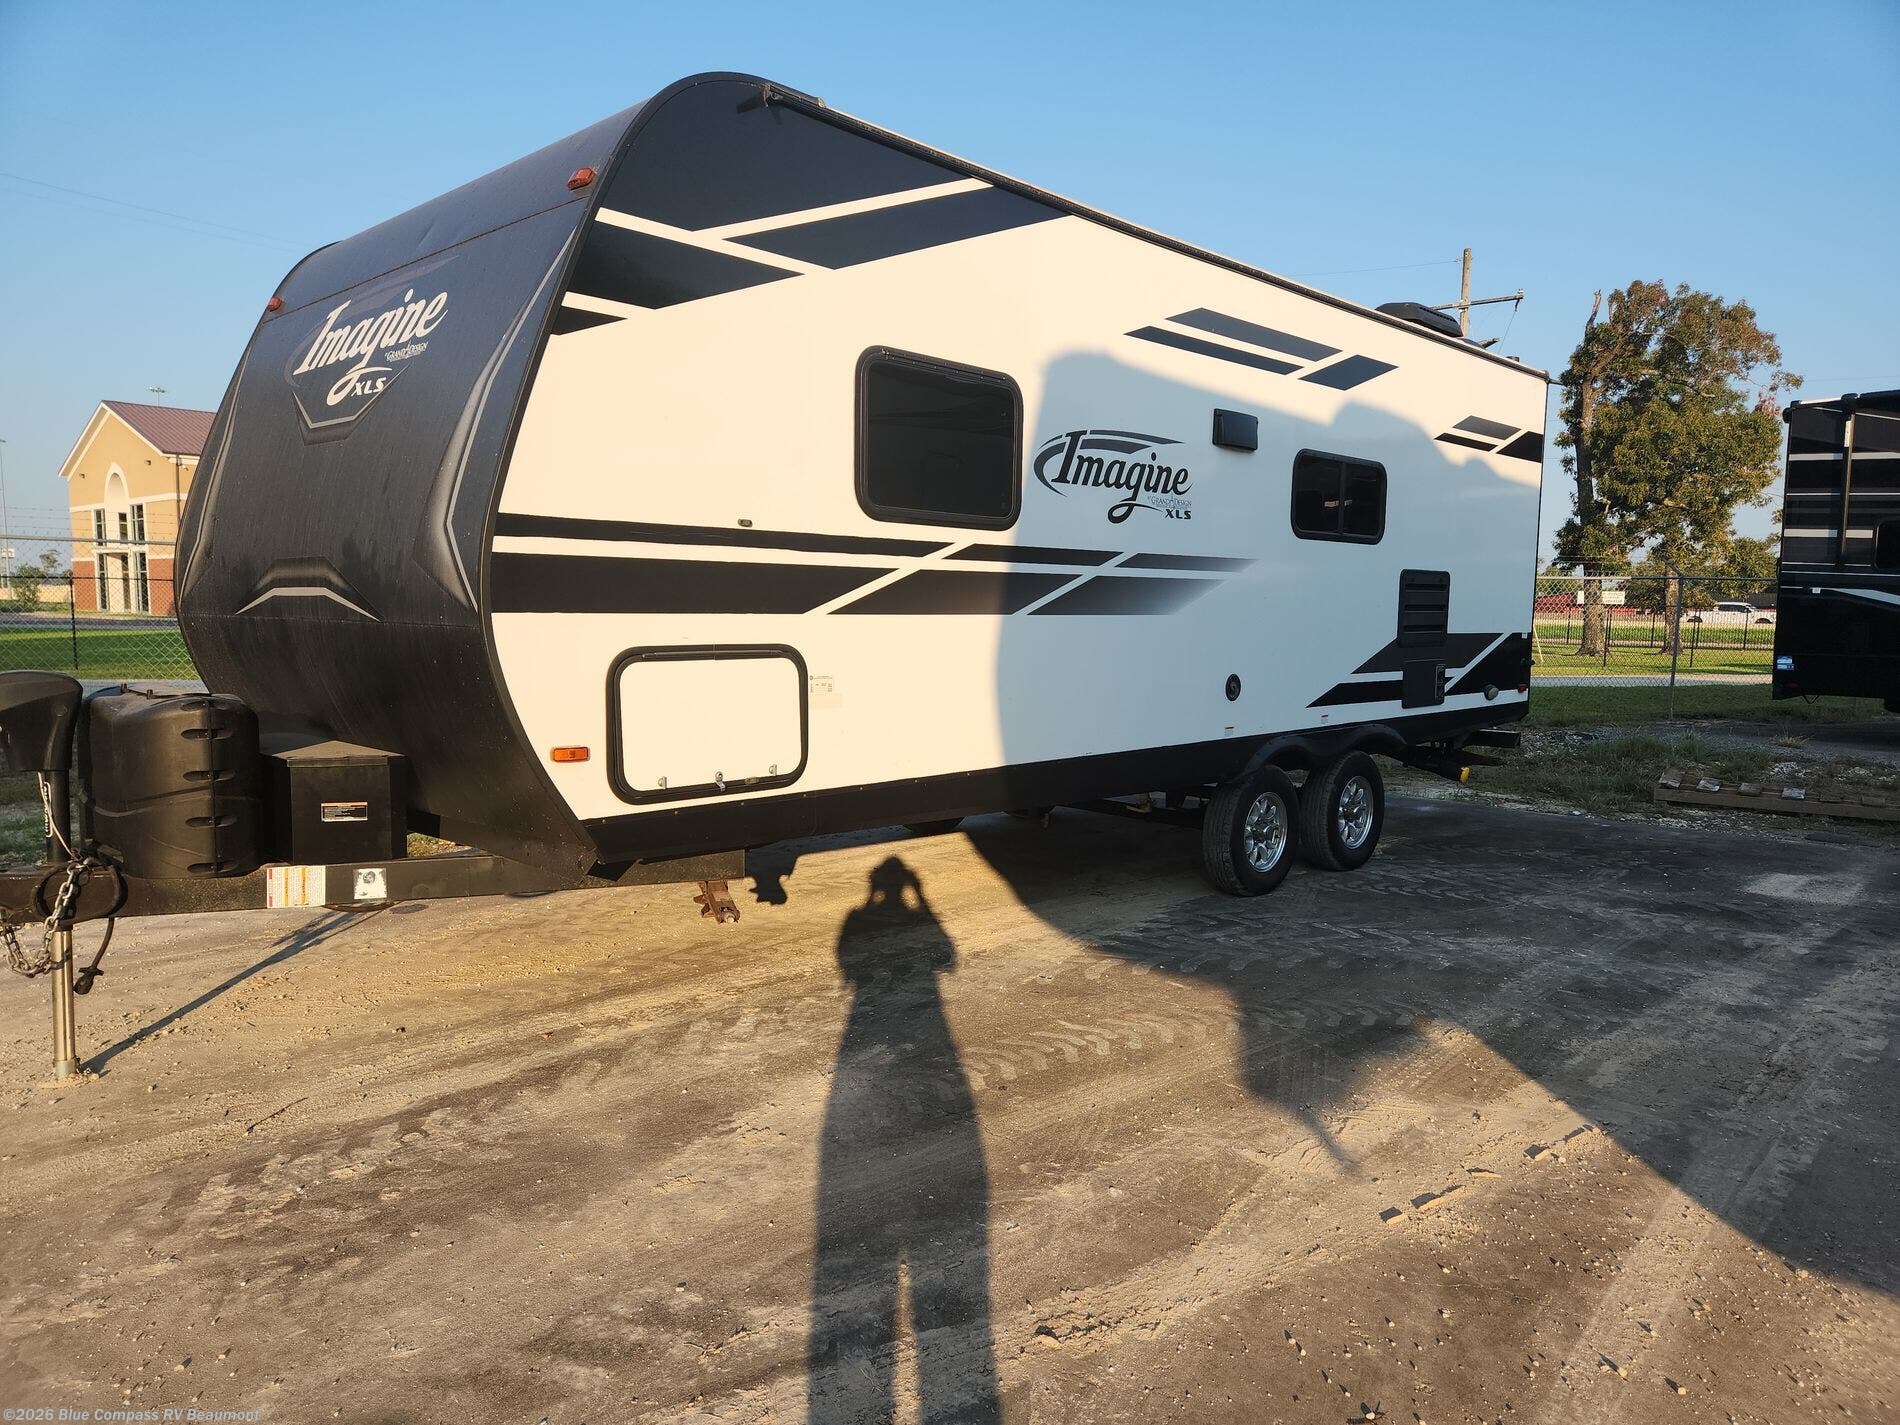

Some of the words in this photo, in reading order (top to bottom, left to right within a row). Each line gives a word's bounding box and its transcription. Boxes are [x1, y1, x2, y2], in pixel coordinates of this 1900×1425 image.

[293, 289, 448, 406] Imagine
[351, 377, 386, 397] XLS
[1051, 430, 1193, 524] Imagine
[1165, 509, 1191, 519] XLS
